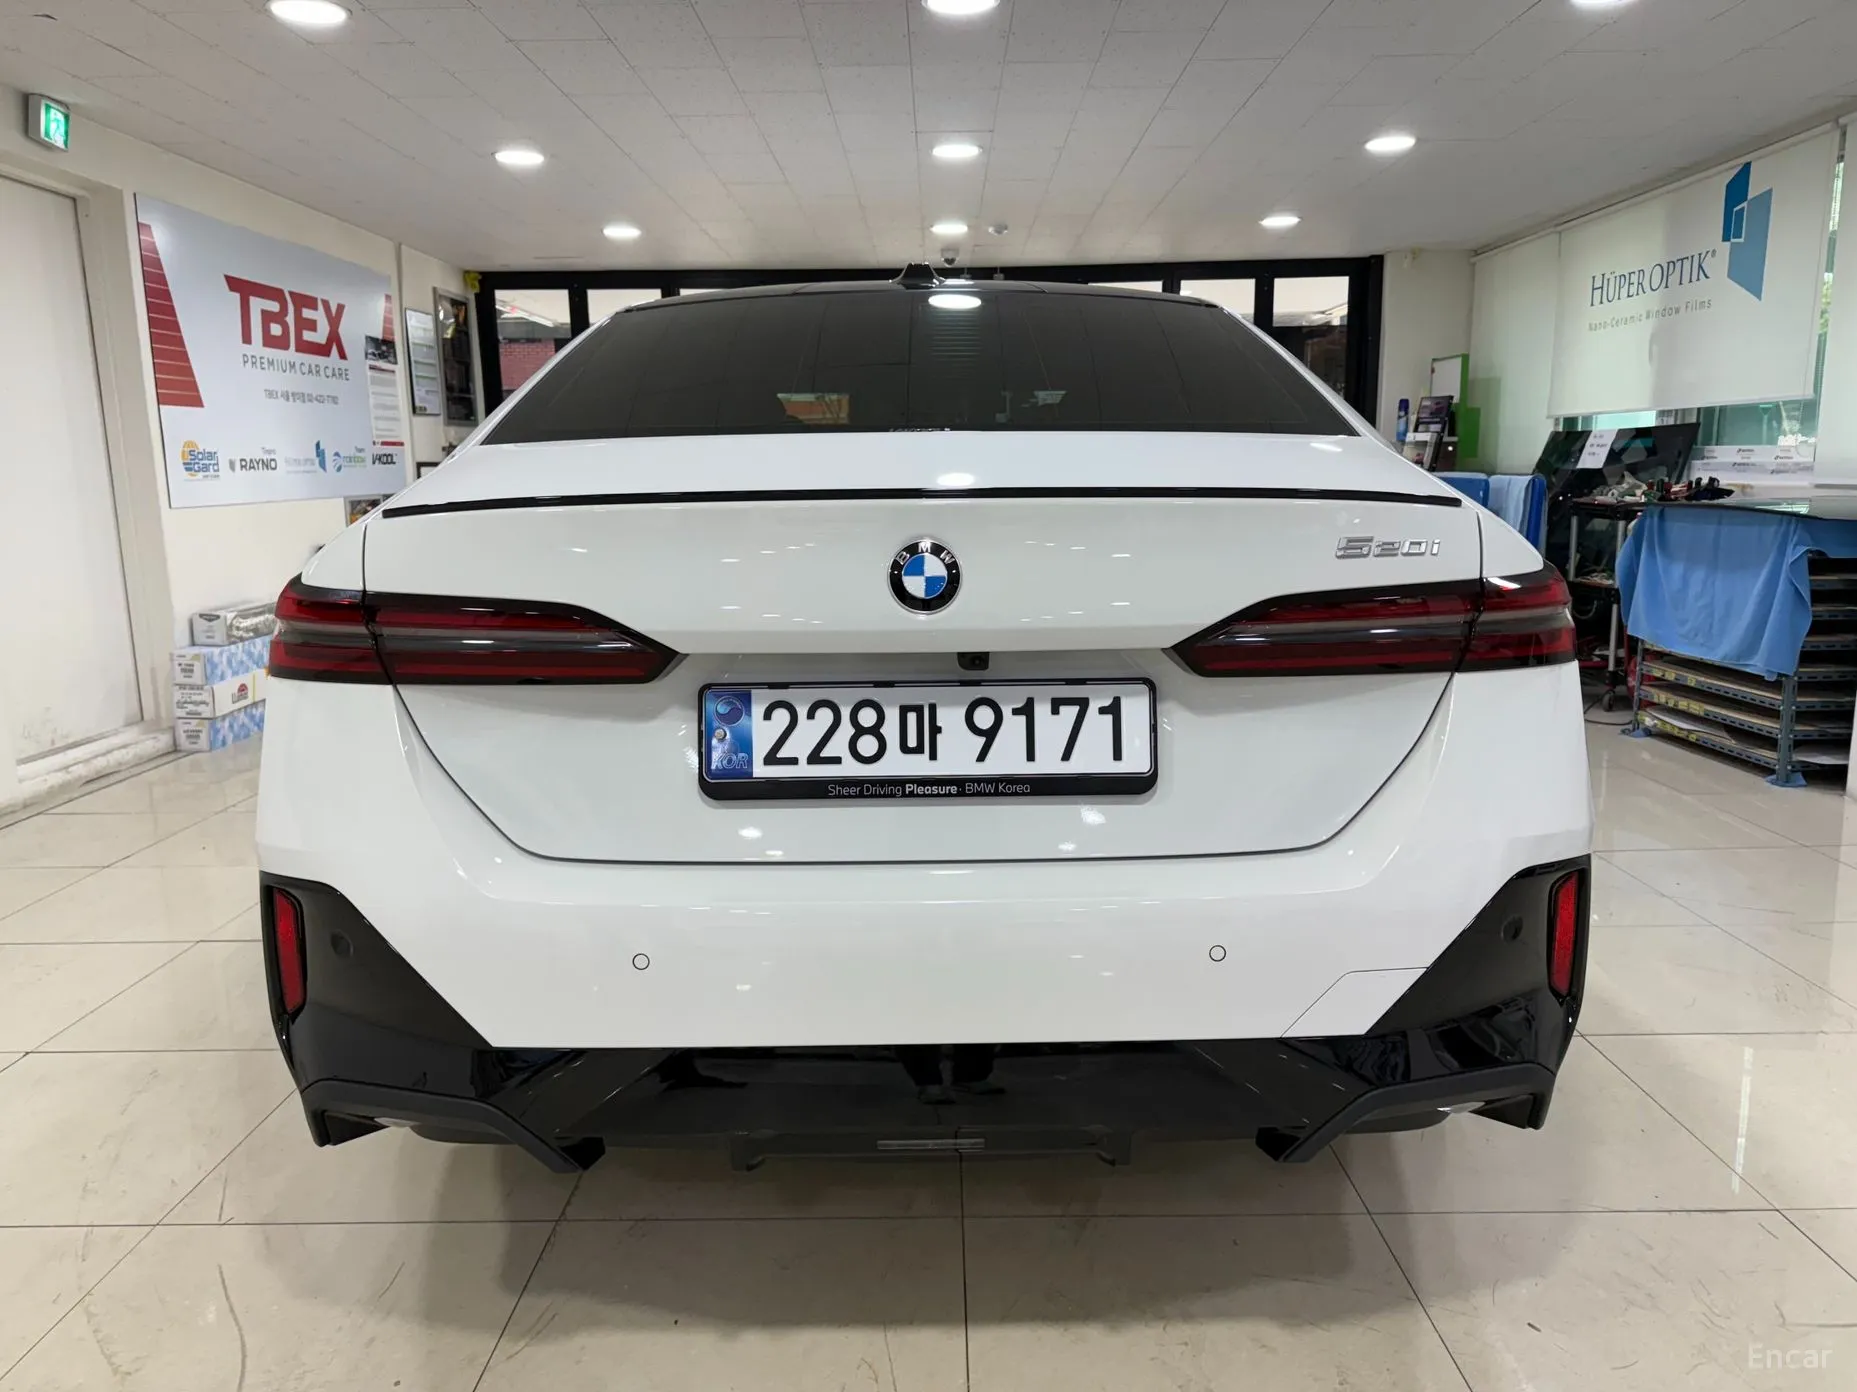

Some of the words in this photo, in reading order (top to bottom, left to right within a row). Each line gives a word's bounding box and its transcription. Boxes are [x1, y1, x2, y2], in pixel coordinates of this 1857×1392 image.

[1590, 269, 1647, 307] HÜPER
[223, 273, 348, 360] TBEX
[1588, 312, 1643, 332] Nano-Ceramic
[1645, 305, 1681, 320] Window
[1685, 299, 1712, 314] Films
[242, 353, 297, 374] PREMIUM
[299, 362, 321, 377] CAR
[323, 366, 350, 381] CARE
[188, 448, 218, 461] Solar
[193, 456, 219, 472] Gard
[240, 458, 278, 471] RAYNO
[895, 541, 956, 565] BMW
[1335, 536, 1440, 559] 520i
[762, 699, 942, 767] 228마
[964, 696, 1123, 763] 9171
[711, 752, 749, 770] KOR
[828, 784, 861, 796] Sheer
[863, 783, 902, 797] Driving
[905, 783, 957, 795] Pleasure
[965, 782, 996, 794] BMW
[998, 782, 1031, 794] Korea
